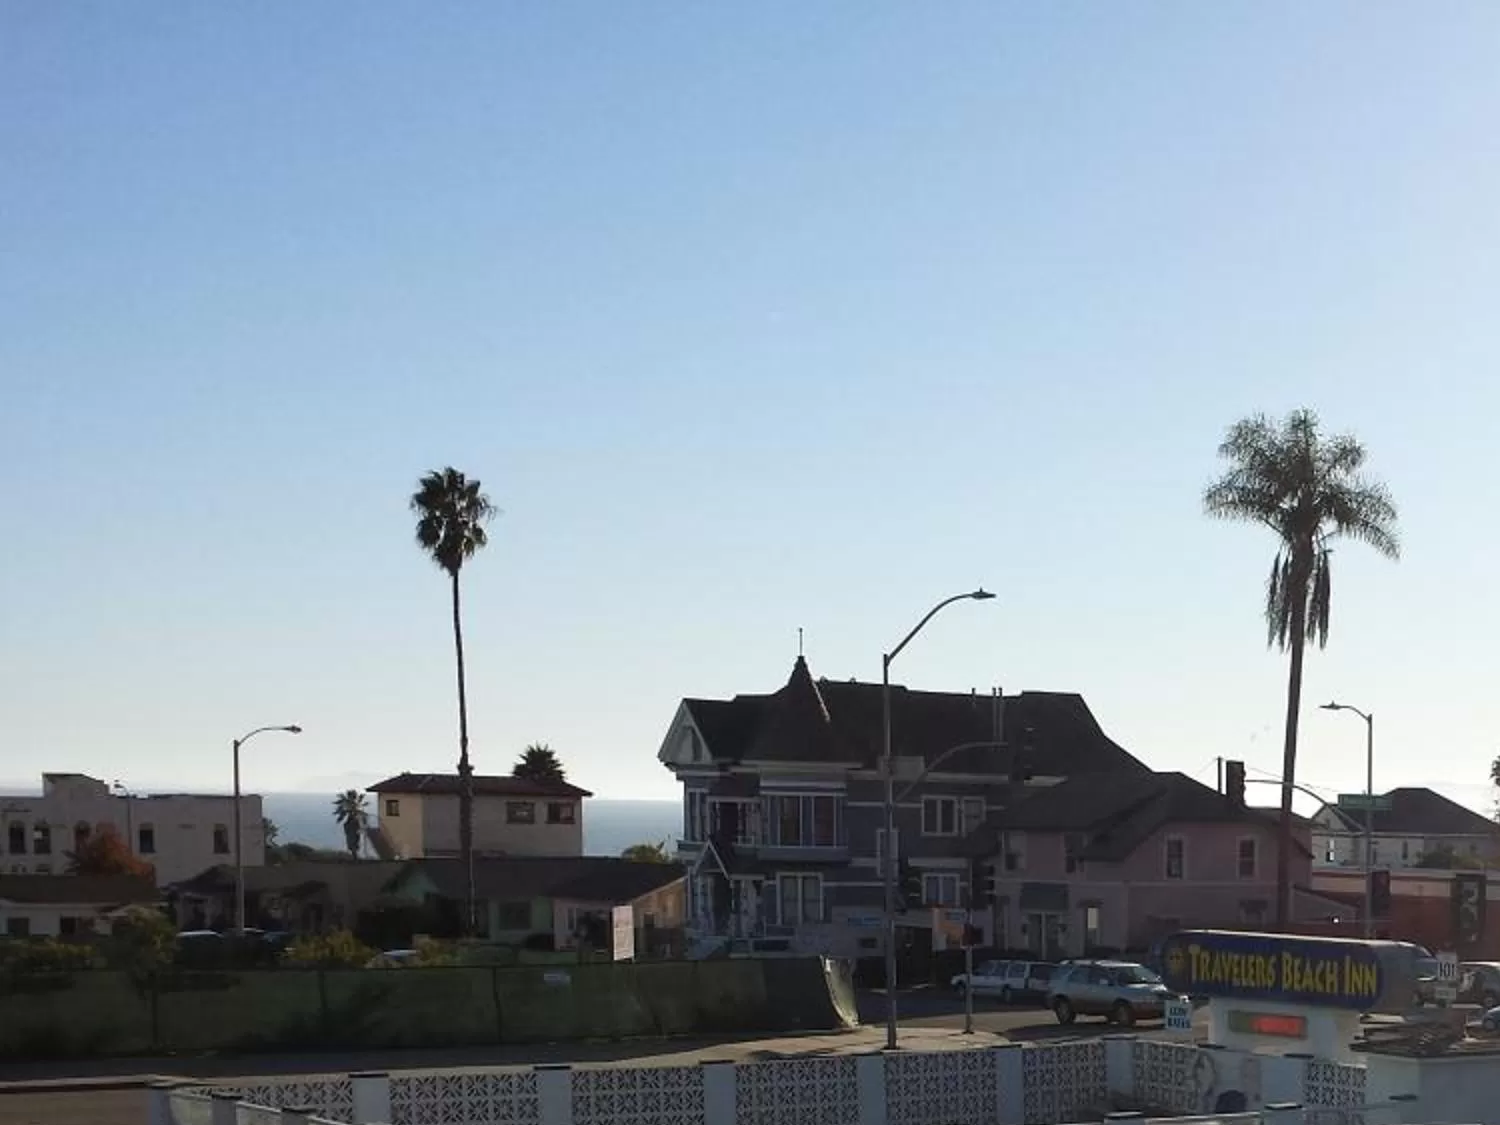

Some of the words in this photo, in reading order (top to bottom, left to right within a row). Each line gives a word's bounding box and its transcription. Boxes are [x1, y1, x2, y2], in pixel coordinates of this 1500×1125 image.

[1188, 944, 1276, 987] TRAVELERS
[1280, 951, 1338, 993] BEACH
[1344, 955, 1377, 995] INN
